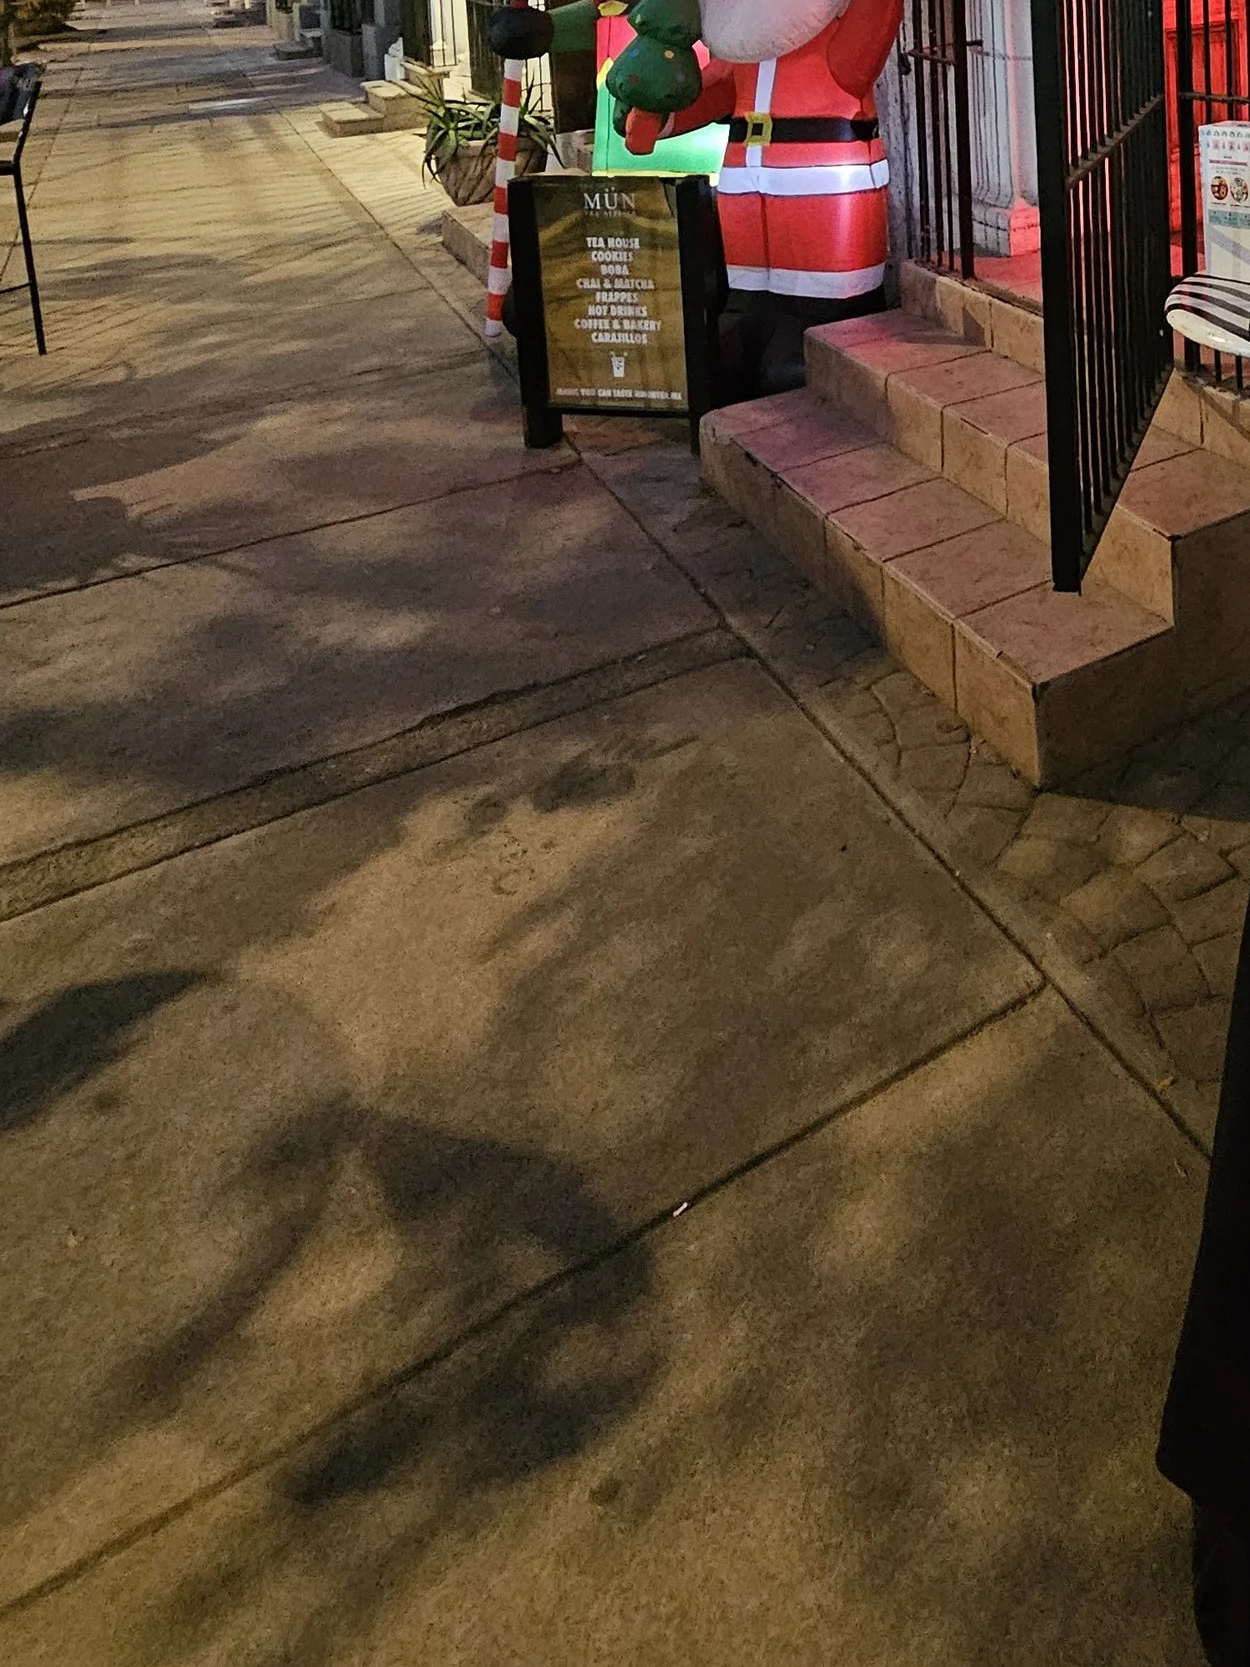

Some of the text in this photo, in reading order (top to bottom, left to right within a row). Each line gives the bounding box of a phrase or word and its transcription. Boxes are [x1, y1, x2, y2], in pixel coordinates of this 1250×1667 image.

[583, 187, 636, 210] MÜN
[586, 237, 640, 249] TEA HOUSE
[591, 251, 633, 262] COOKIES
[600, 265, 629, 275] BOBA
[576, 278, 655, 289] CHAI & MATCHA
[595, 291, 638, 303] FRAPPES
[588, 305, 648, 317] HOT DRINKS
[573, 318, 661, 331] COFFEE & BAKERY
[591, 332, 648, 344] CARAJILLOS
